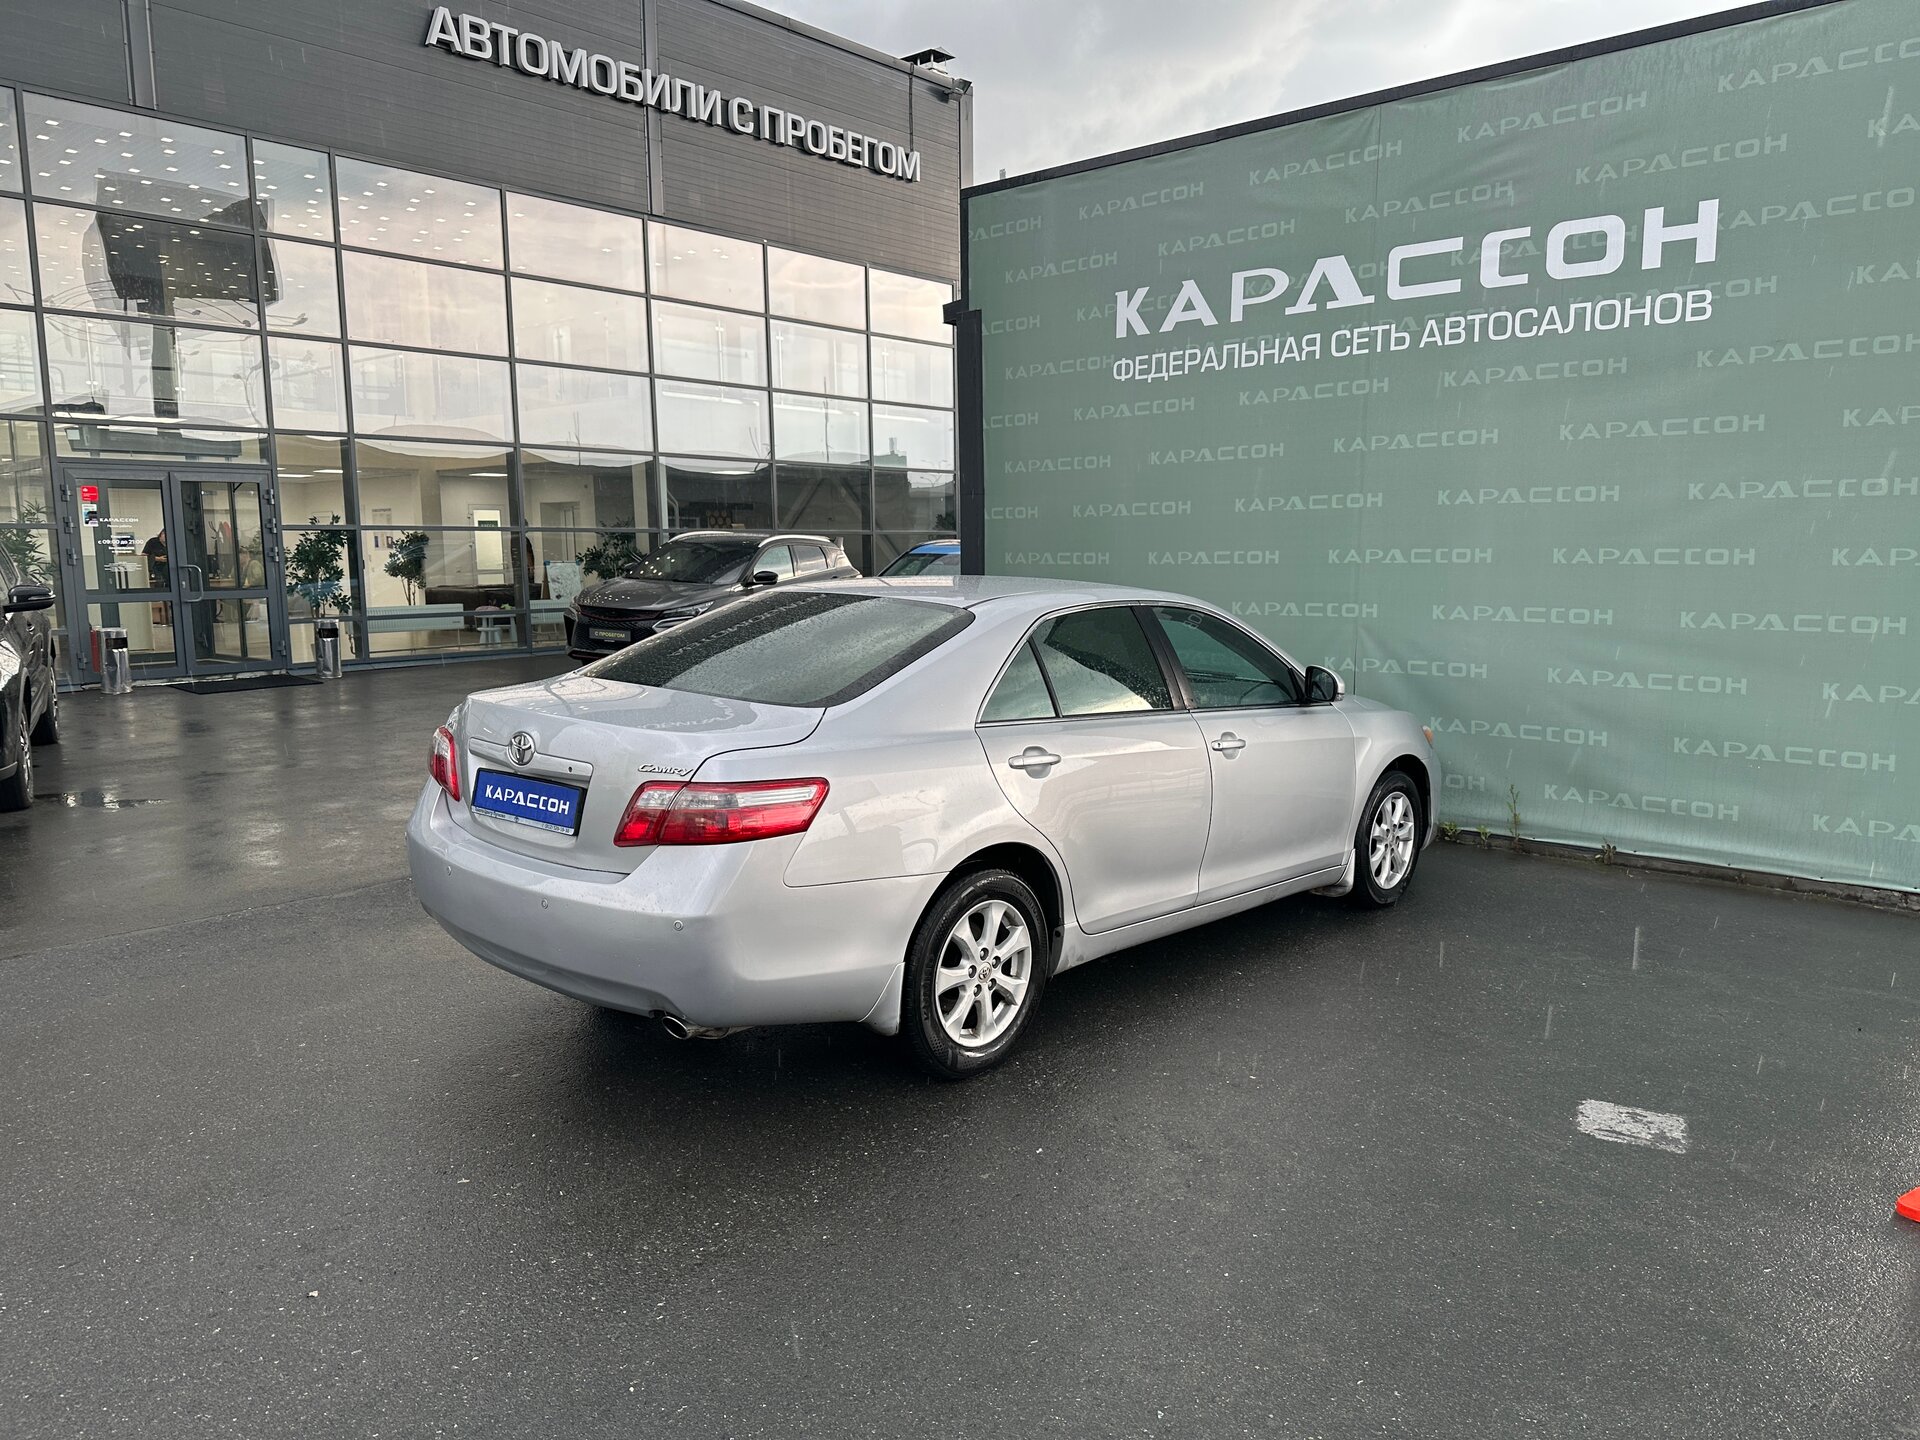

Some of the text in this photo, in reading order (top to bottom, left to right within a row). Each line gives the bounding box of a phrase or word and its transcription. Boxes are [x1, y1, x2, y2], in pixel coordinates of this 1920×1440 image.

[425, 7, 921, 182] АВТОМОБИЛИ С ПРОБЕГОМ
[1458, 91, 1647, 143] КАРАССОН
[1248, 140, 1402, 186] КАРАССОН
[1575, 133, 1788, 185] КАРАССОН
[1079, 182, 1204, 221] КАРАССОН
[1345, 180, 1514, 224] КАРАССОН
[1718, 187, 1915, 230] АРАССО
[1158, 218, 1295, 257] КАРАССОН
[1005, 251, 1118, 284] КАРАССОН
[1114, 198, 1720, 339] КАРАССОН
[1856, 260, 1920, 285] КА
[1113, 289, 1713, 383] ФЕДЕРАЛЬНАЯ СЕТЬ АВТОСАЛОНОВ
[1004, 355, 1115, 380] КАРАССОН
[1444, 356, 1628, 388] КАРАССОН
[1239, 377, 1389, 406] КАРАССОН
[1073, 397, 1195, 422] КАРАССОН
[1334, 427, 1499, 453] КАРАССОН
[1559, 413, 1766, 441] КАРАССОН
[1004, 455, 1112, 474] КАРАССОН
[1150, 443, 1285, 465] КАРАССОН
[1235, 492, 1383, 513] КАРАССОН
[1437, 485, 1620, 506] КАРАССОН
[1688, 477, 1919, 501] КАРАССОН
[1073, 500, 1192, 518] КАРАССОН
[1004, 551, 1110, 565] КАРАССОН
[1148, 550, 1280, 565] КАРАССОН
[1328, 547, 1493, 565] КАРАССОН
[1553, 547, 1756, 566] КАРАССОН
[1831, 547, 1920, 567] КАР
[1232, 601, 1378, 618] КАРАССОН
[1432, 605, 1613, 626] КАРАССОН
[1680, 611, 1907, 635] КАРАССОН
[1547, 667, 1748, 695] КАРАССОН
[1673, 737, 1896, 772] КАРАССОН
[485, 784, 570, 815] КАРАССОН
[1545, 784, 1739, 821] КАРАССОН
